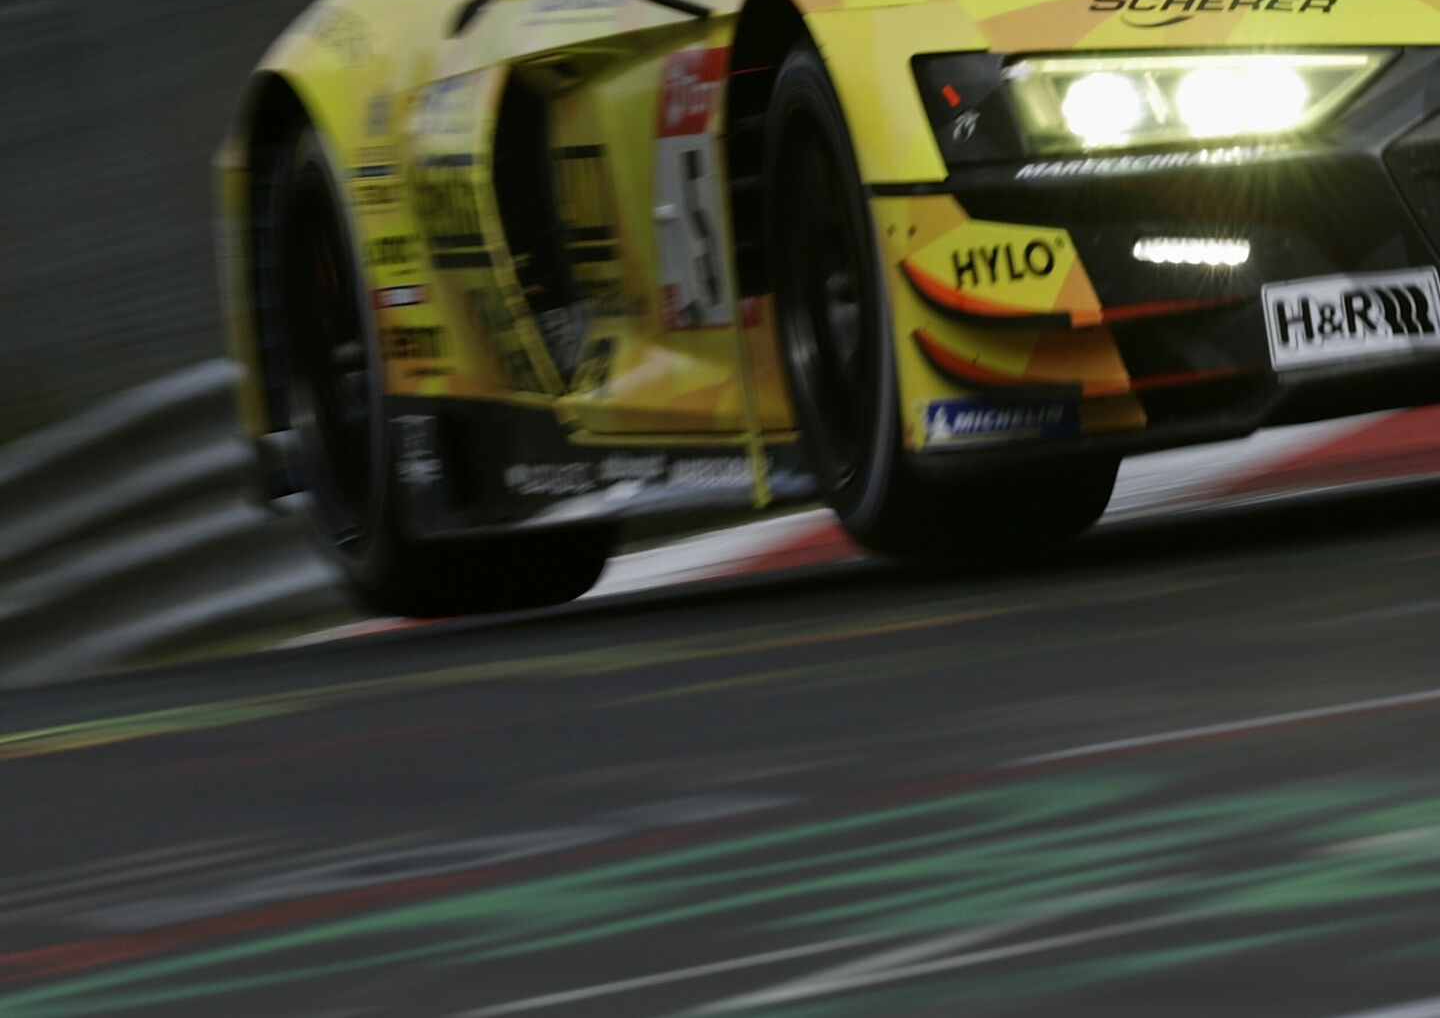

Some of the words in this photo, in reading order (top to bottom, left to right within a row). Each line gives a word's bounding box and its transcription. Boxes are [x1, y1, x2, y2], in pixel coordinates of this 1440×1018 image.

[952, 239, 1055, 288] HYLO
[1274, 288, 1379, 346] H&R
[952, 403, 1065, 433] MICHELIN
